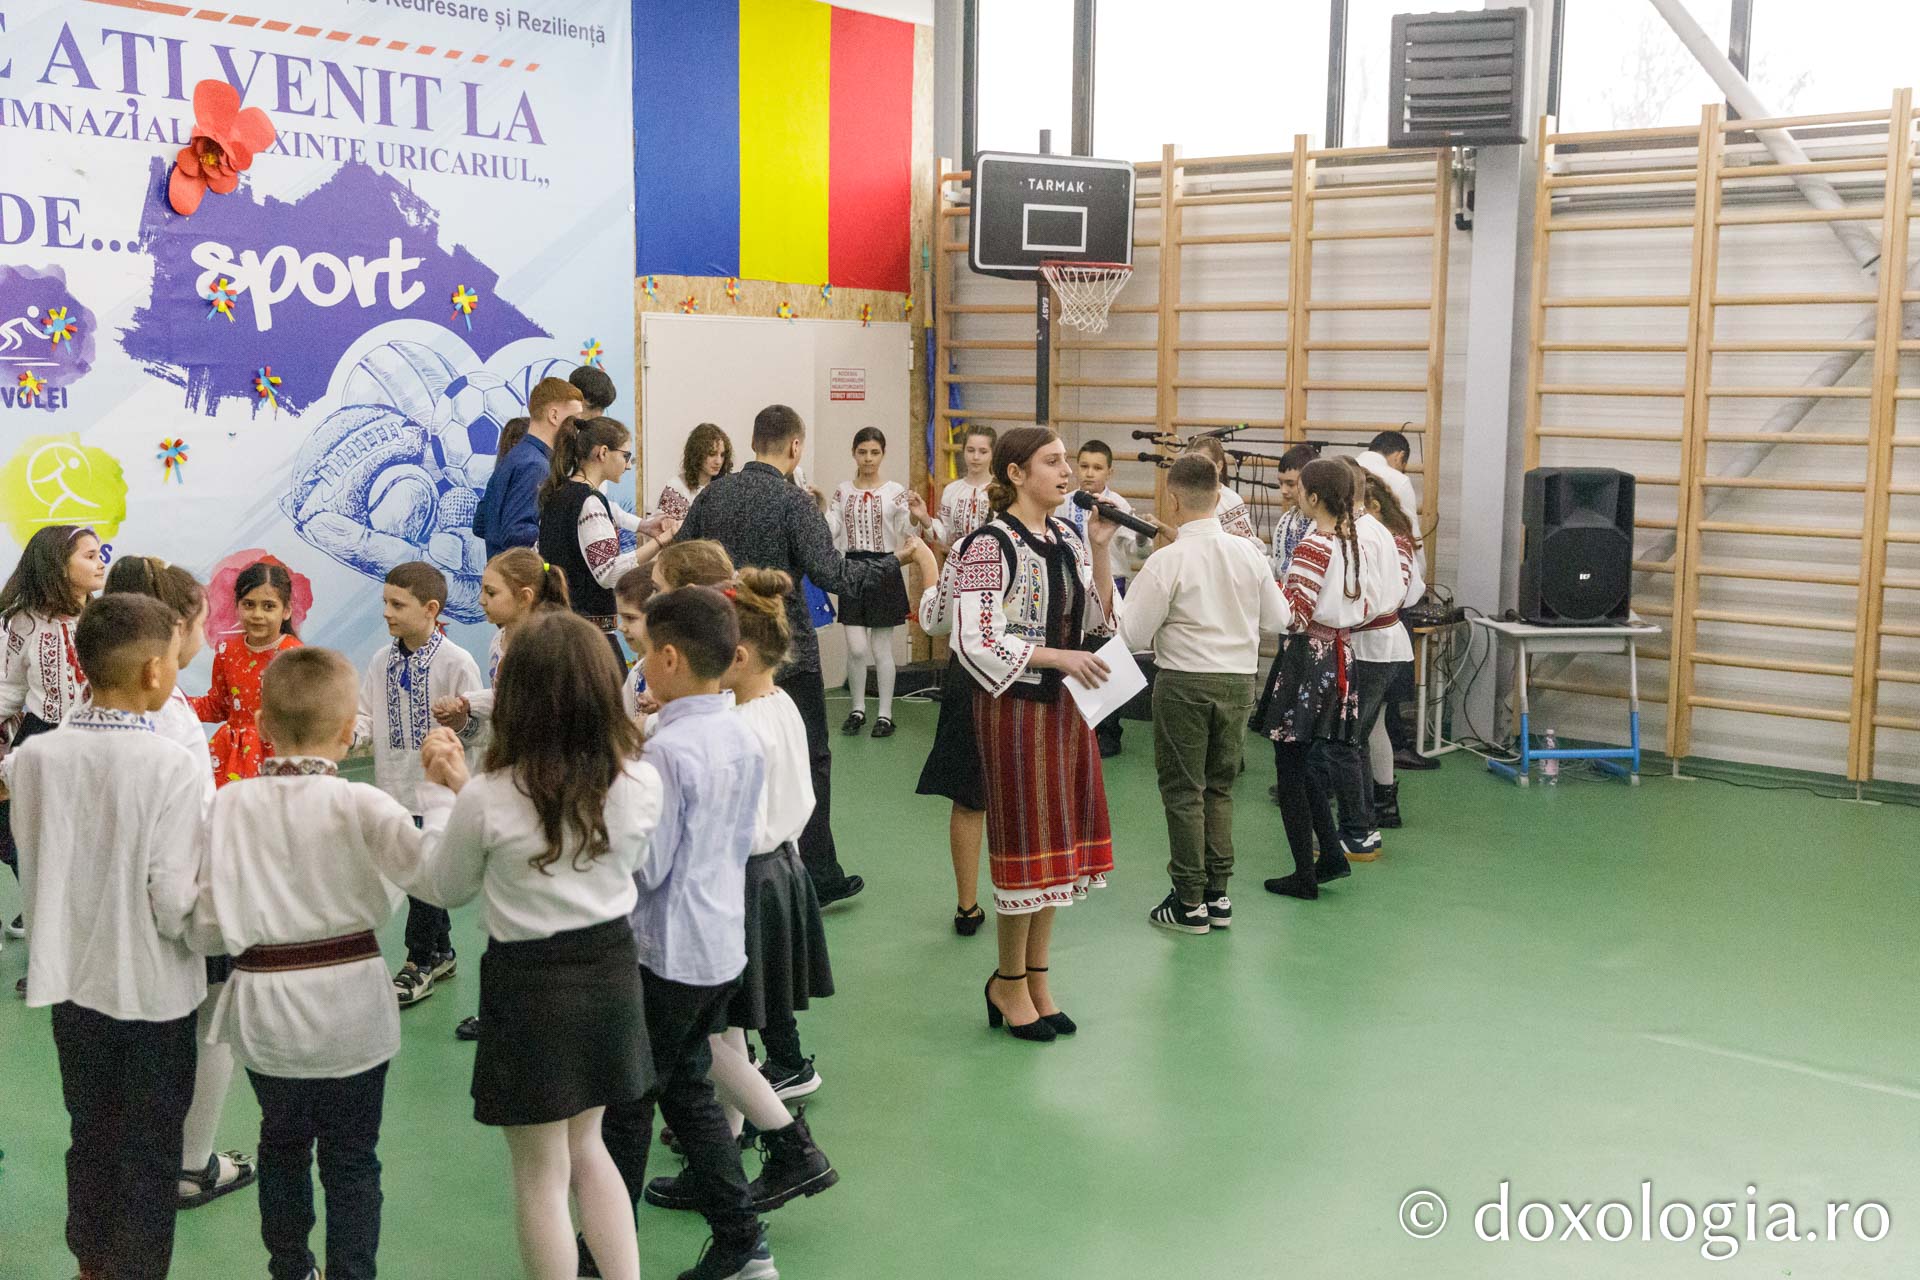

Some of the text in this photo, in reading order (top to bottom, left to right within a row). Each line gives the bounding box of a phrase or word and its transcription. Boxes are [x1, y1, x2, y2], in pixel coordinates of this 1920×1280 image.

[495, 10, 511, 31] și
[517, 11, 606, 47] Reziliență
[210, 44, 442, 131] VENIT
[459, 81, 547, 146] LA
[260, 129, 367, 165] XINTE
[1028, 178, 1085, 193] TARMAK
[191, 237, 427, 332] sport
[1042, 297, 1050, 320] EASY
[0, 386, 68, 409] VOLEI
